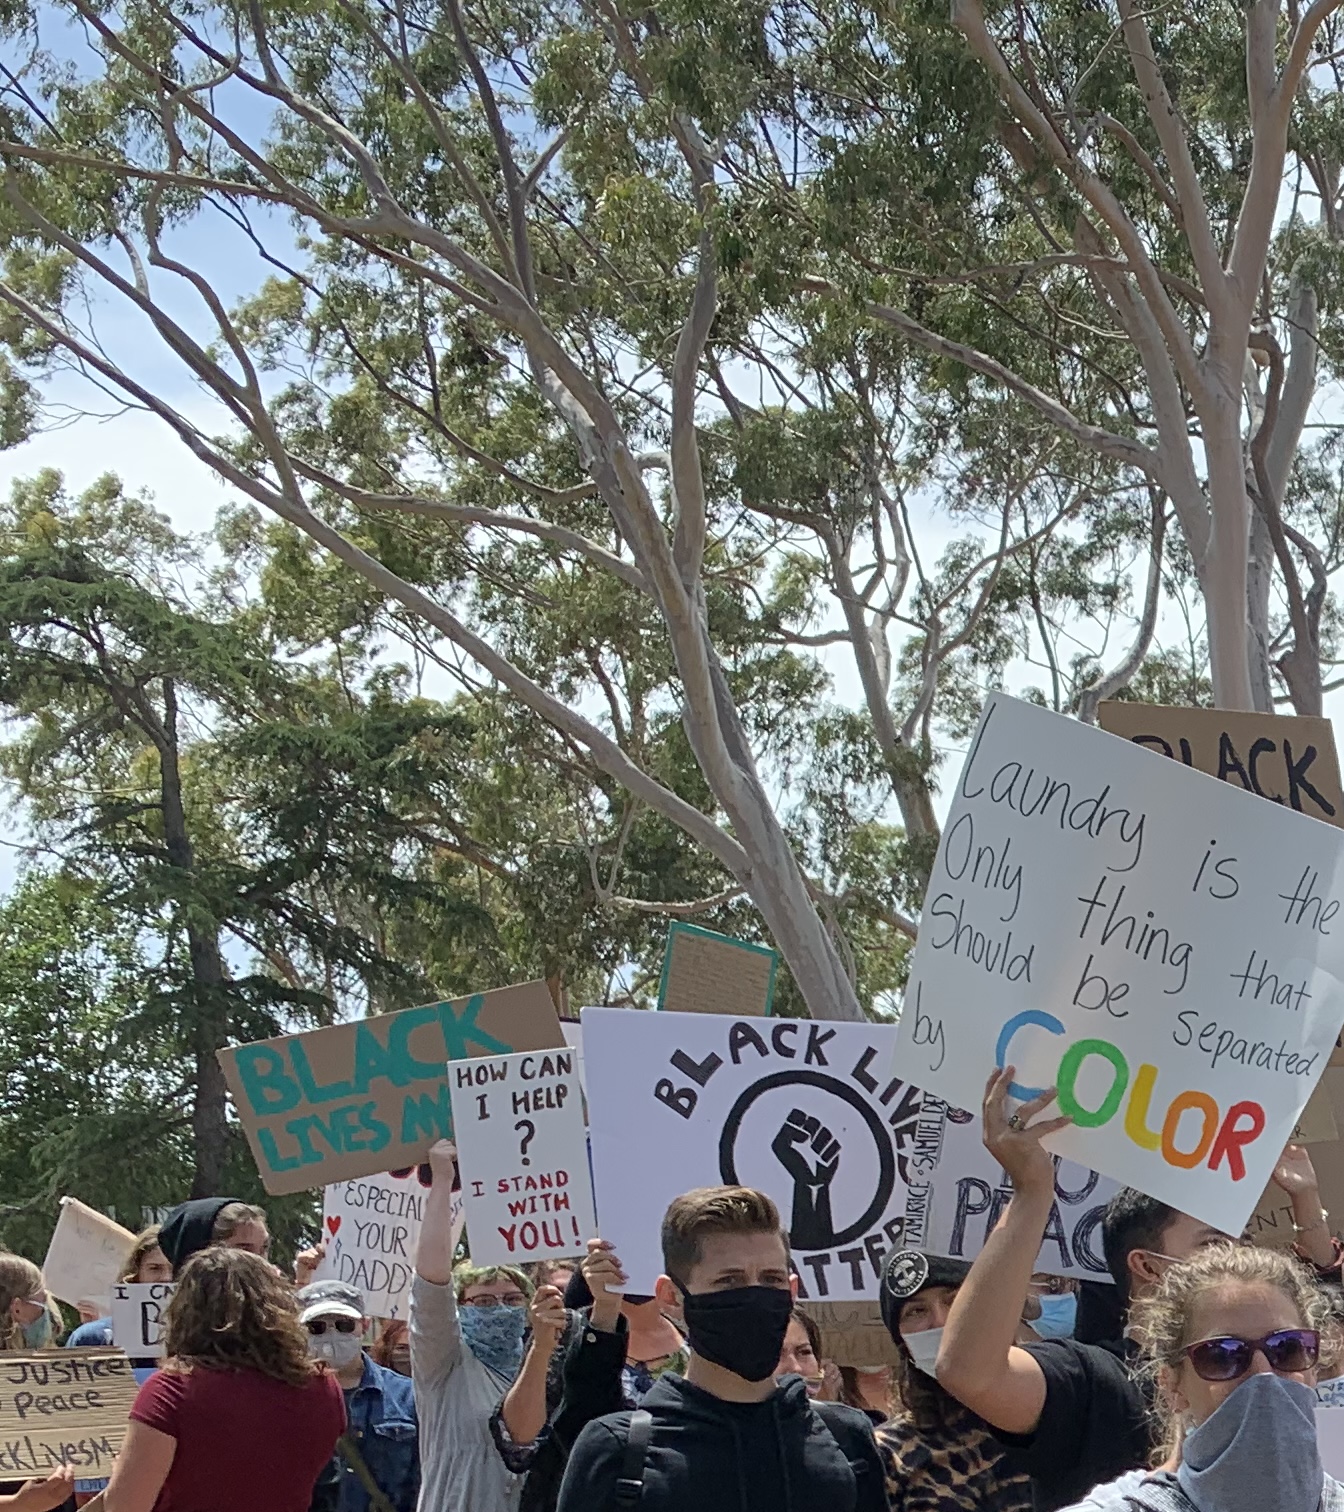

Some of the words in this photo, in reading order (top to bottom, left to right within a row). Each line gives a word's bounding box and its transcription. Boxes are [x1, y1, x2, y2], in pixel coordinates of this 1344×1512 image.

[960, 702, 1145, 872] Laundry
[1193, 839, 1240, 898] is
[1278, 865, 1340, 935] the
[945, 813, 1022, 922] Only
[1078, 875, 1193, 994] thing
[1230, 950, 1312, 1012] that
[1073, 954, 1130, 1018] be
[235, 993, 515, 1116] BLACK
[455, 1064, 509, 1092] HOW
[519, 1049, 573, 1081] CAN
[655, 1022, 837, 1120] BLACK
[913, 982, 946, 1072] by
[996, 1009, 1266, 1182] COLOR
[477, 1096, 488, 1121] I
[511, 1083, 569, 1114] HELP
[257, 1099, 392, 1173] LIVES
[514, 1120, 536, 1167] ?
[472, 1180, 485, 1198] I
[496, 1169, 570, 1196] STAND
[508, 1191, 570, 1218] WITH
[354, 1219, 409, 1258] YOUR
[115, 1286, 129, 1300] I
